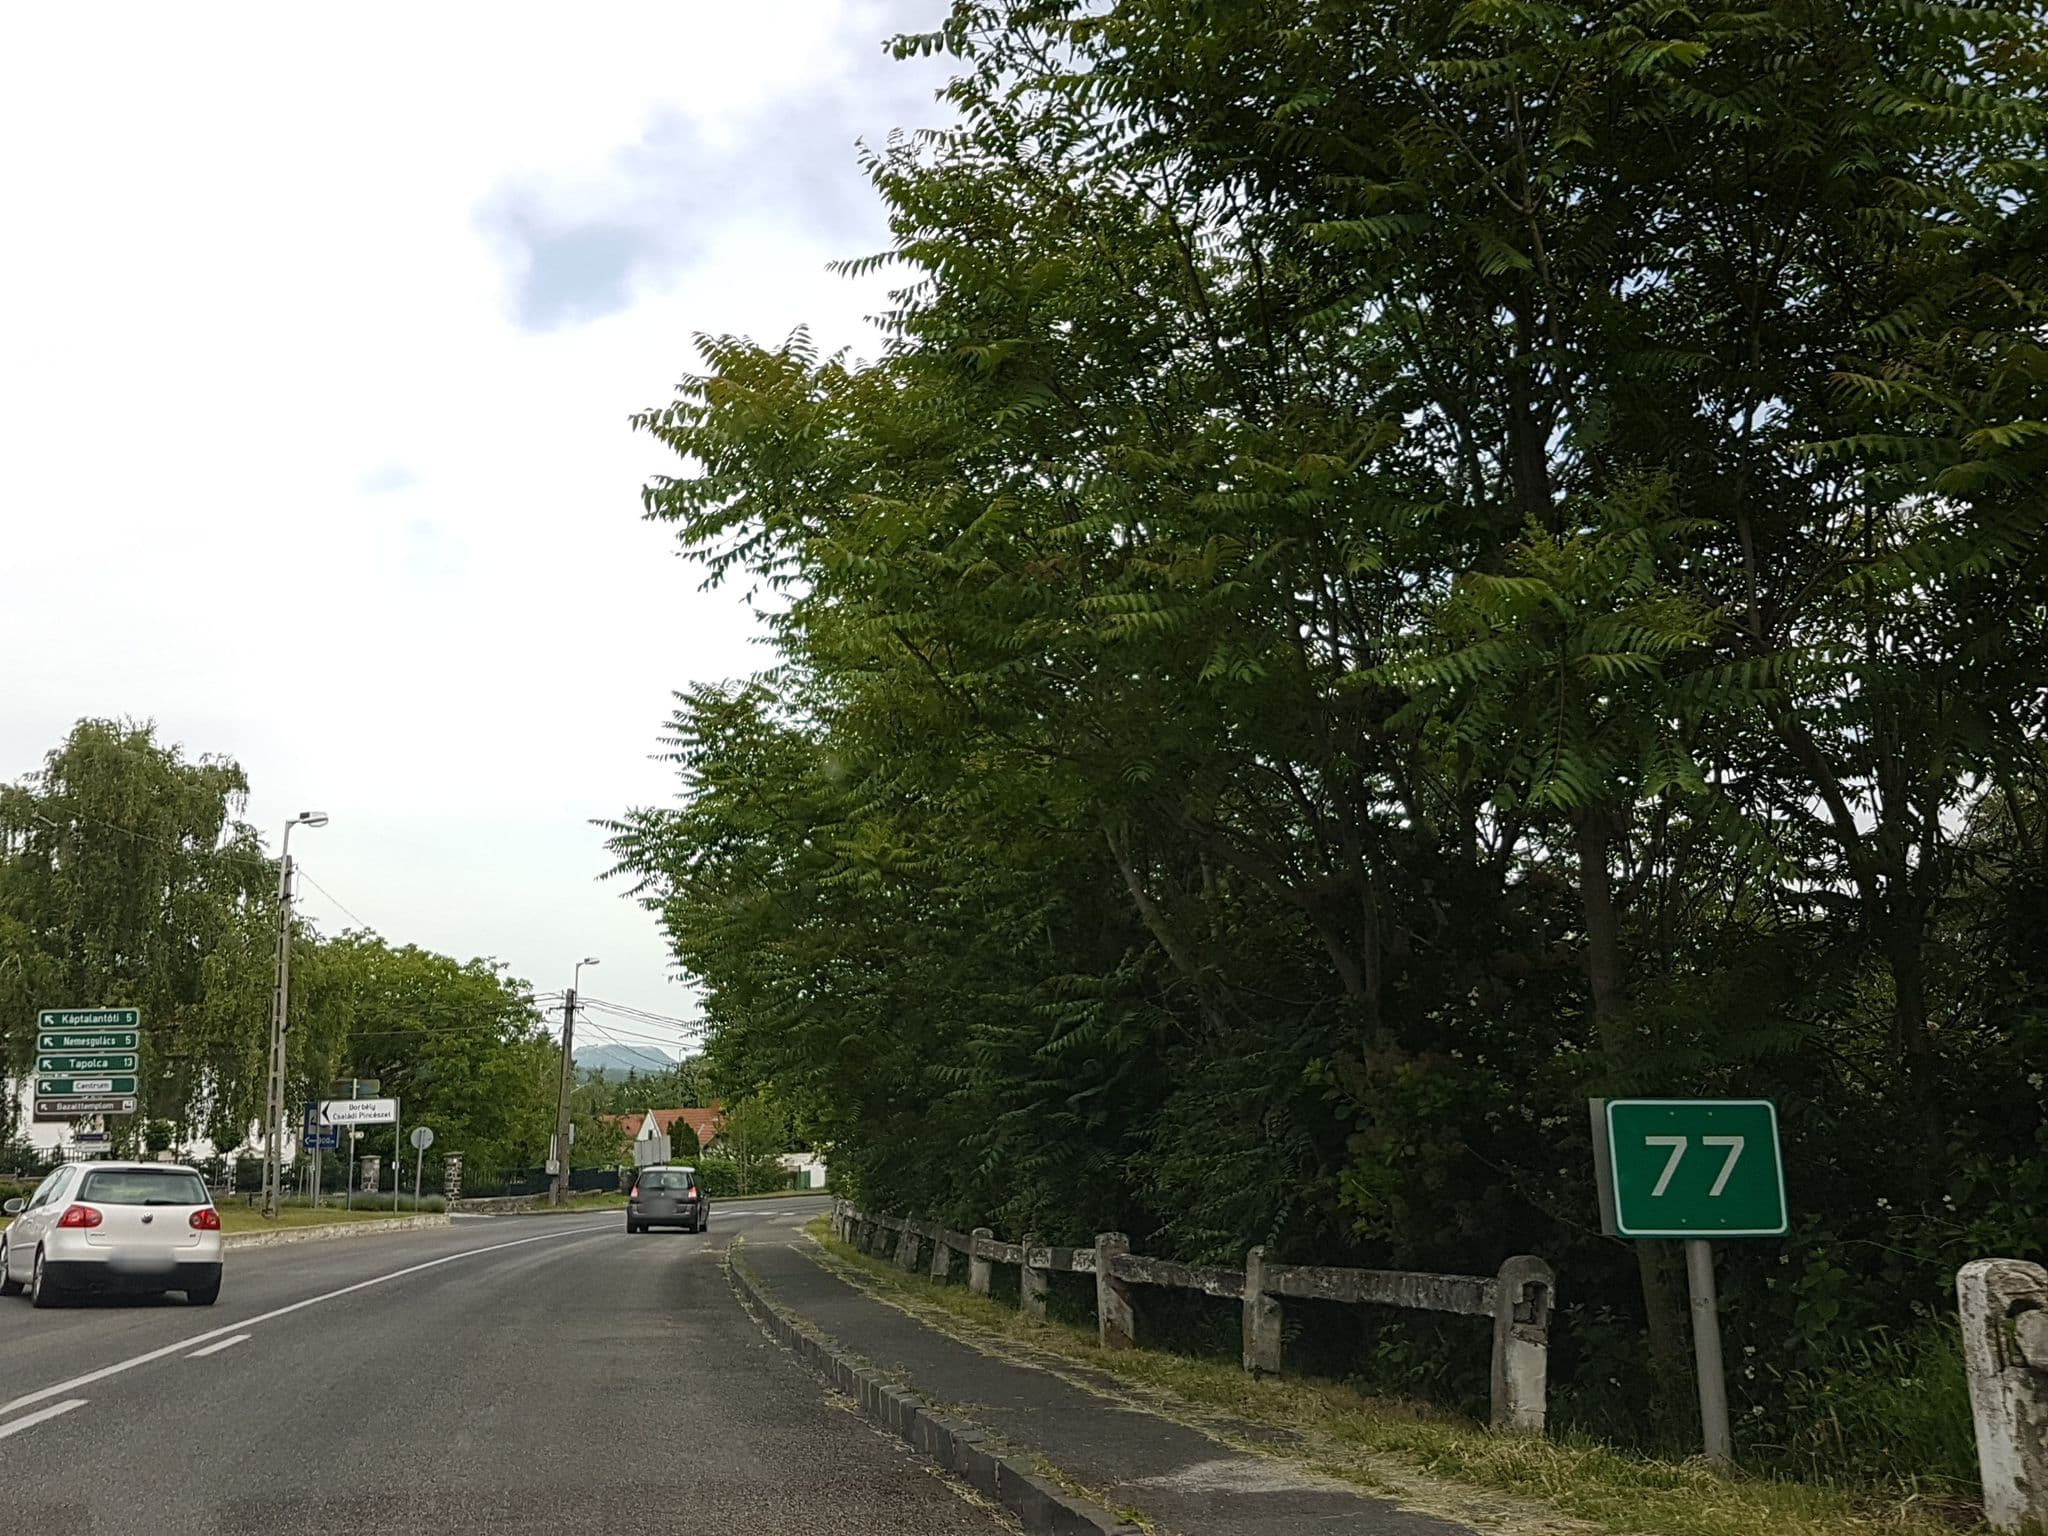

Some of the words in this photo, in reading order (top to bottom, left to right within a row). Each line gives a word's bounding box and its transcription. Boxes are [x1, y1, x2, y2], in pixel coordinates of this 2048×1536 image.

[126, 1012, 133, 1023] 5
[125, 1035, 132, 1045] 5
[69, 1058, 109, 1070] Tapolca
[124, 1057, 133, 1067] 13
[75, 1082, 110, 1090] Centrum
[1645, 1135, 1745, 1197] 77
